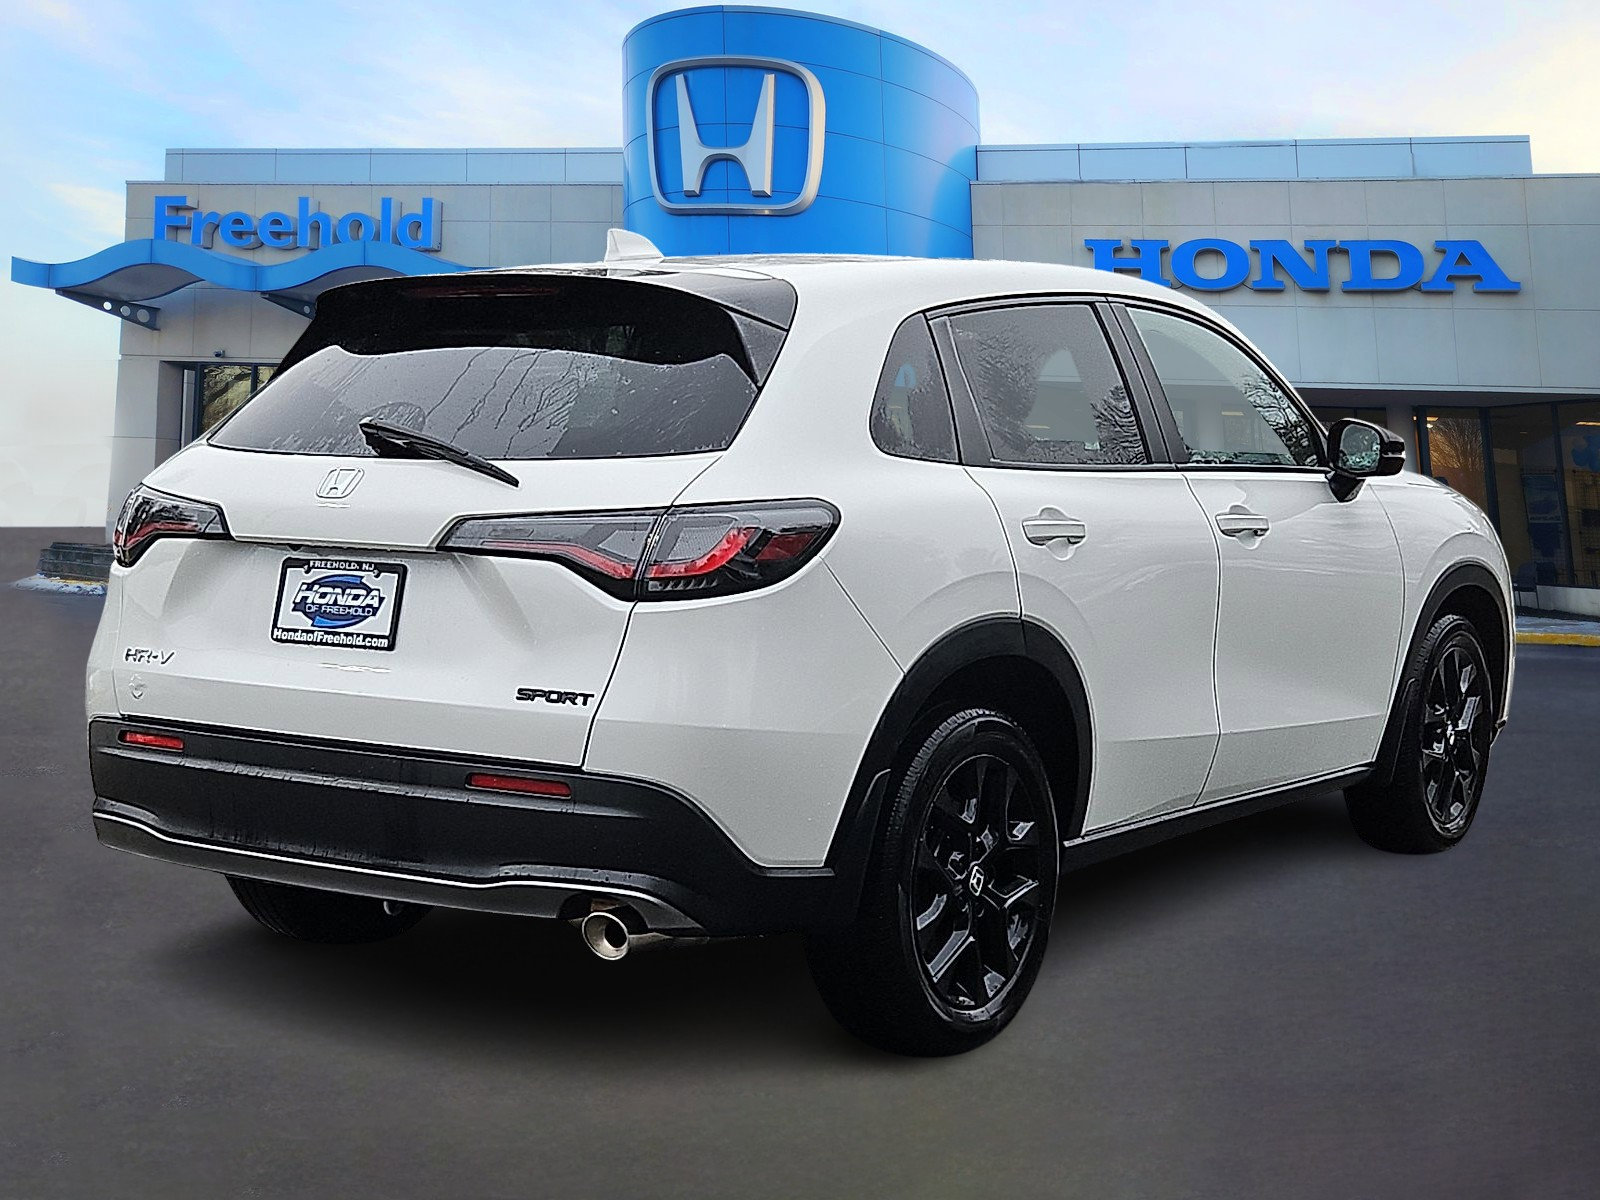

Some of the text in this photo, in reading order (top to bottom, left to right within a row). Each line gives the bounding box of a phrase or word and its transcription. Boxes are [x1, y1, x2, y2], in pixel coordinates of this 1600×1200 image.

[154, 195, 436, 249] Freehold
[1084, 238, 1521, 292] HONDA
[362, 562, 375, 571] NJ
[294, 584, 380, 608] HONDA
[305, 604, 373, 616] OF FREEHOLD
[272, 627, 389, 648] HondaofFreehold.com
[124, 647, 175, 665] HR-V
[515, 687, 595, 706] SPORT
